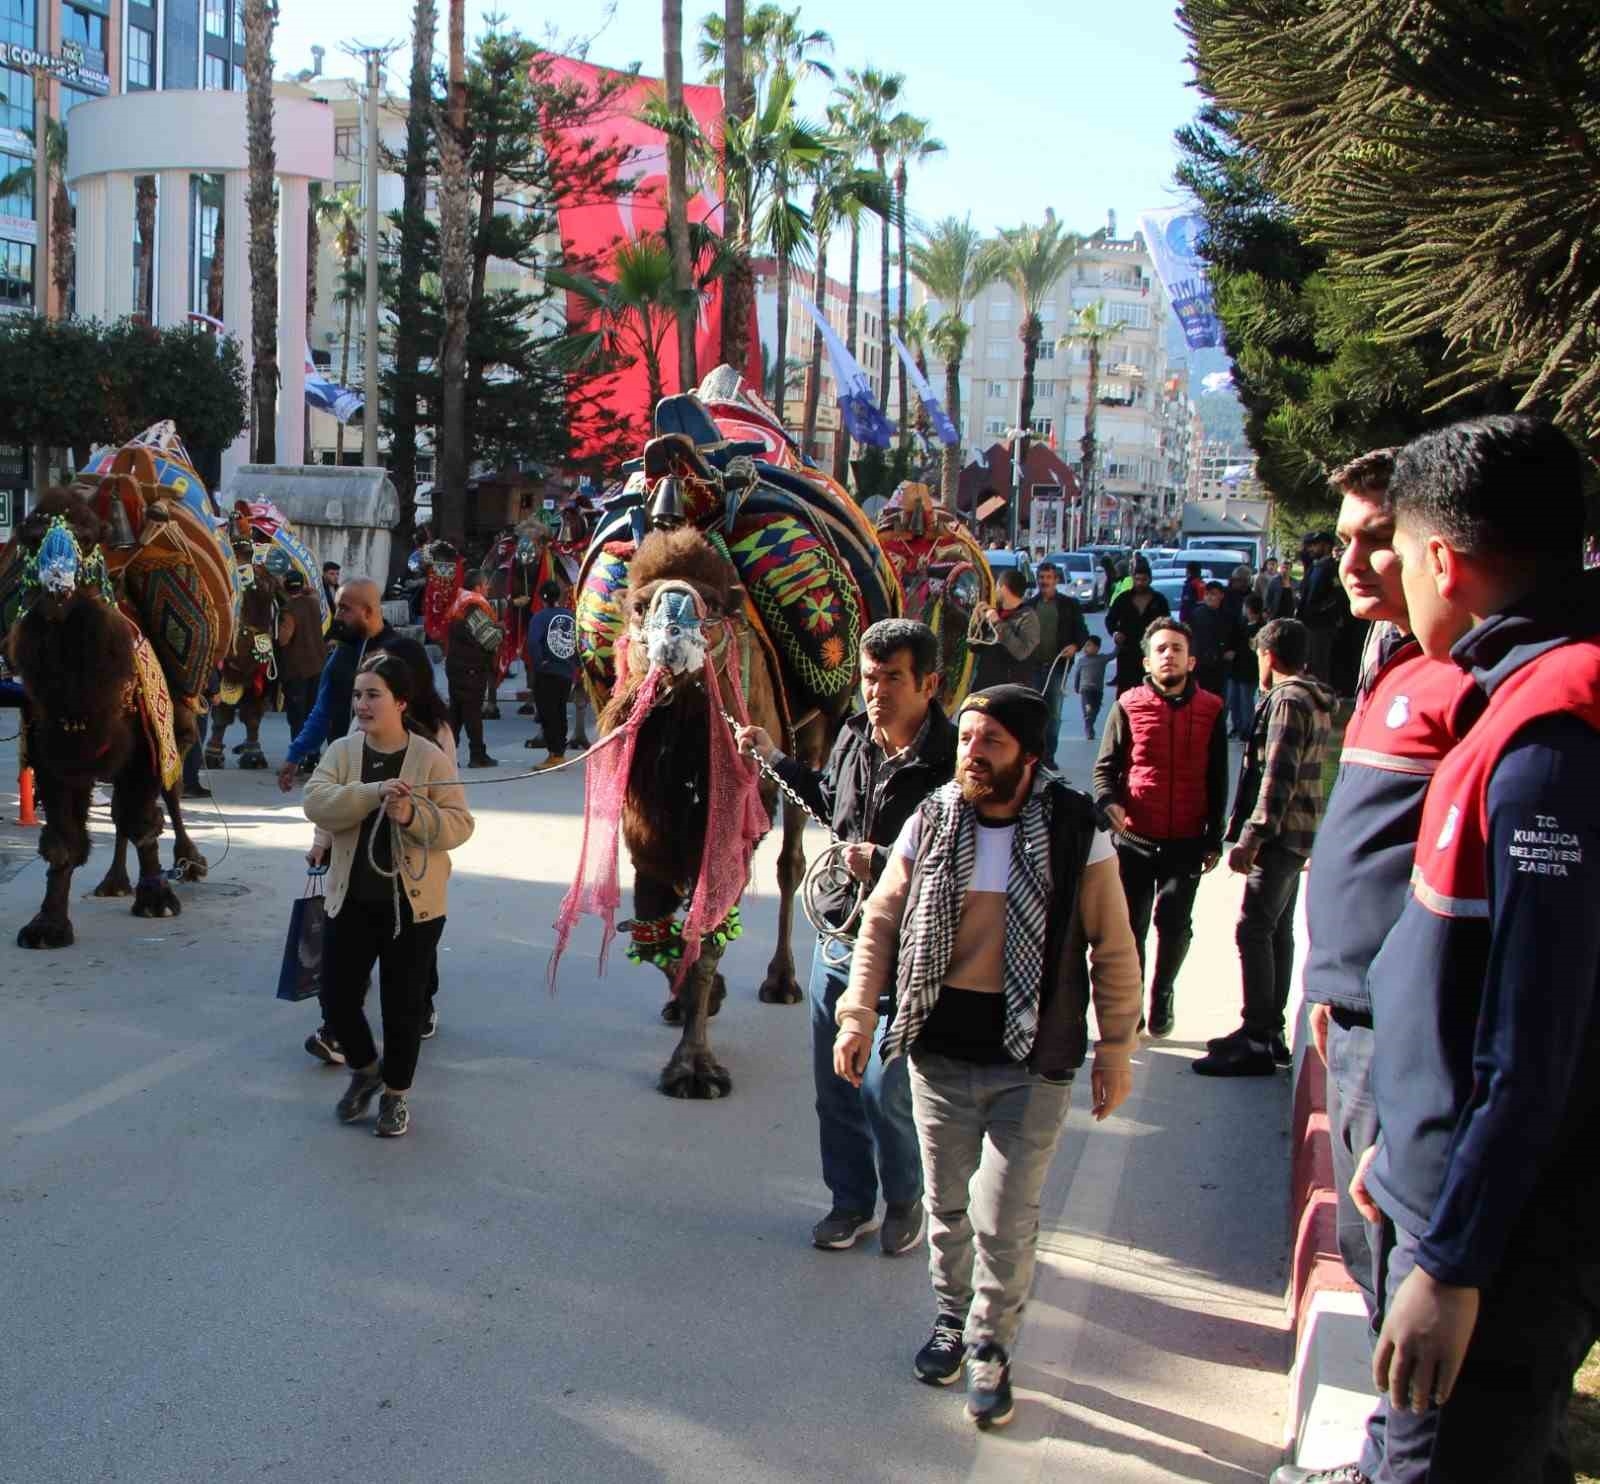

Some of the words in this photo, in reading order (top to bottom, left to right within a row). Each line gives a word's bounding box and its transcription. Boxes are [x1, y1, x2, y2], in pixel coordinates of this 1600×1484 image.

[1513, 829, 1579, 846] KUMLUCA
[1509, 846, 1582, 863] BELEDİYESİ
[1517, 861, 1568, 876] ZABITA
